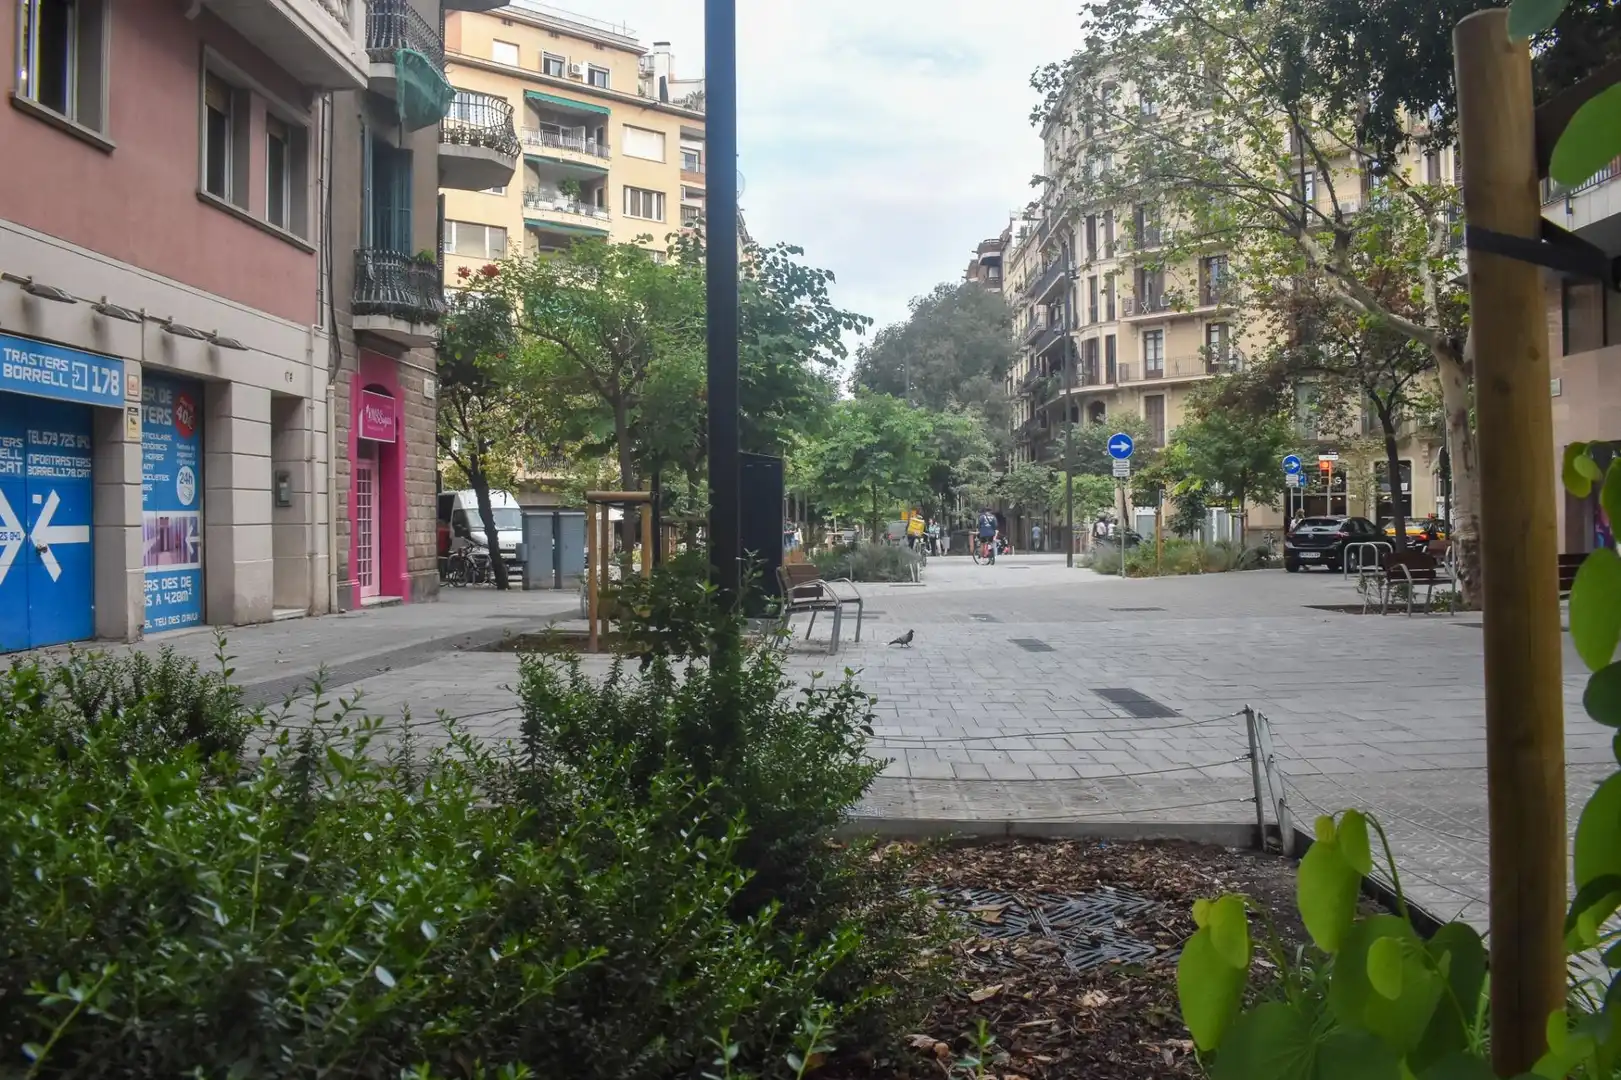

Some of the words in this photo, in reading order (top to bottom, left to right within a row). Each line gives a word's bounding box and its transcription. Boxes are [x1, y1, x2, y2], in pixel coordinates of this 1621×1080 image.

[3, 347, 69, 372] TRASTERS
[2, 362, 69, 388] BORRELL
[91, 364, 120, 396] 178
[179, 471, 193, 485] 24h
[161, 577, 178, 590] DES
[181, 576, 192, 588] DE
[156, 593, 162, 606] A
